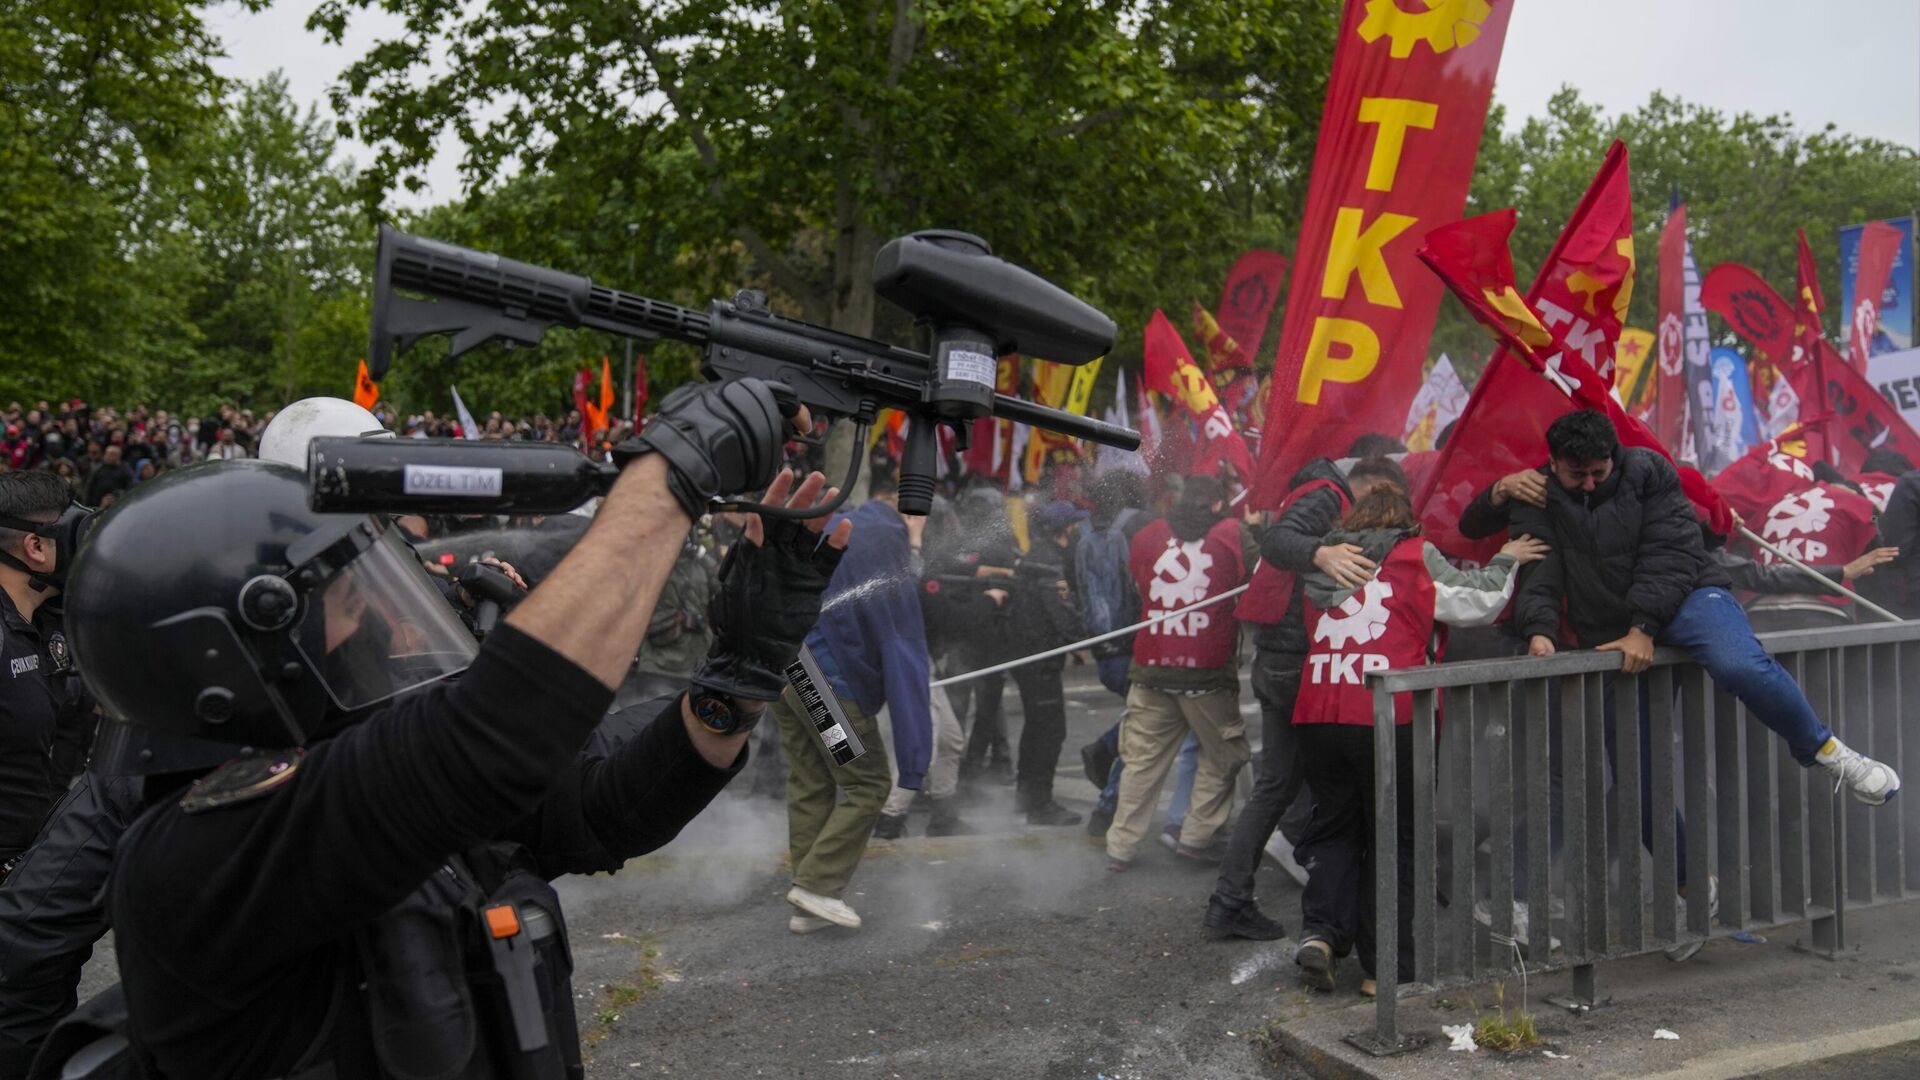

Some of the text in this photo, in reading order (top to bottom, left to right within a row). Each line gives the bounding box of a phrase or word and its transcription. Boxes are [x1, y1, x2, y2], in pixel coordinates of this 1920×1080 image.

[1296, 97, 1439, 405] TKP
[1535, 297, 1615, 380] TK
[1147, 609, 1210, 637] TKP
[1309, 653, 1390, 685] TKP
